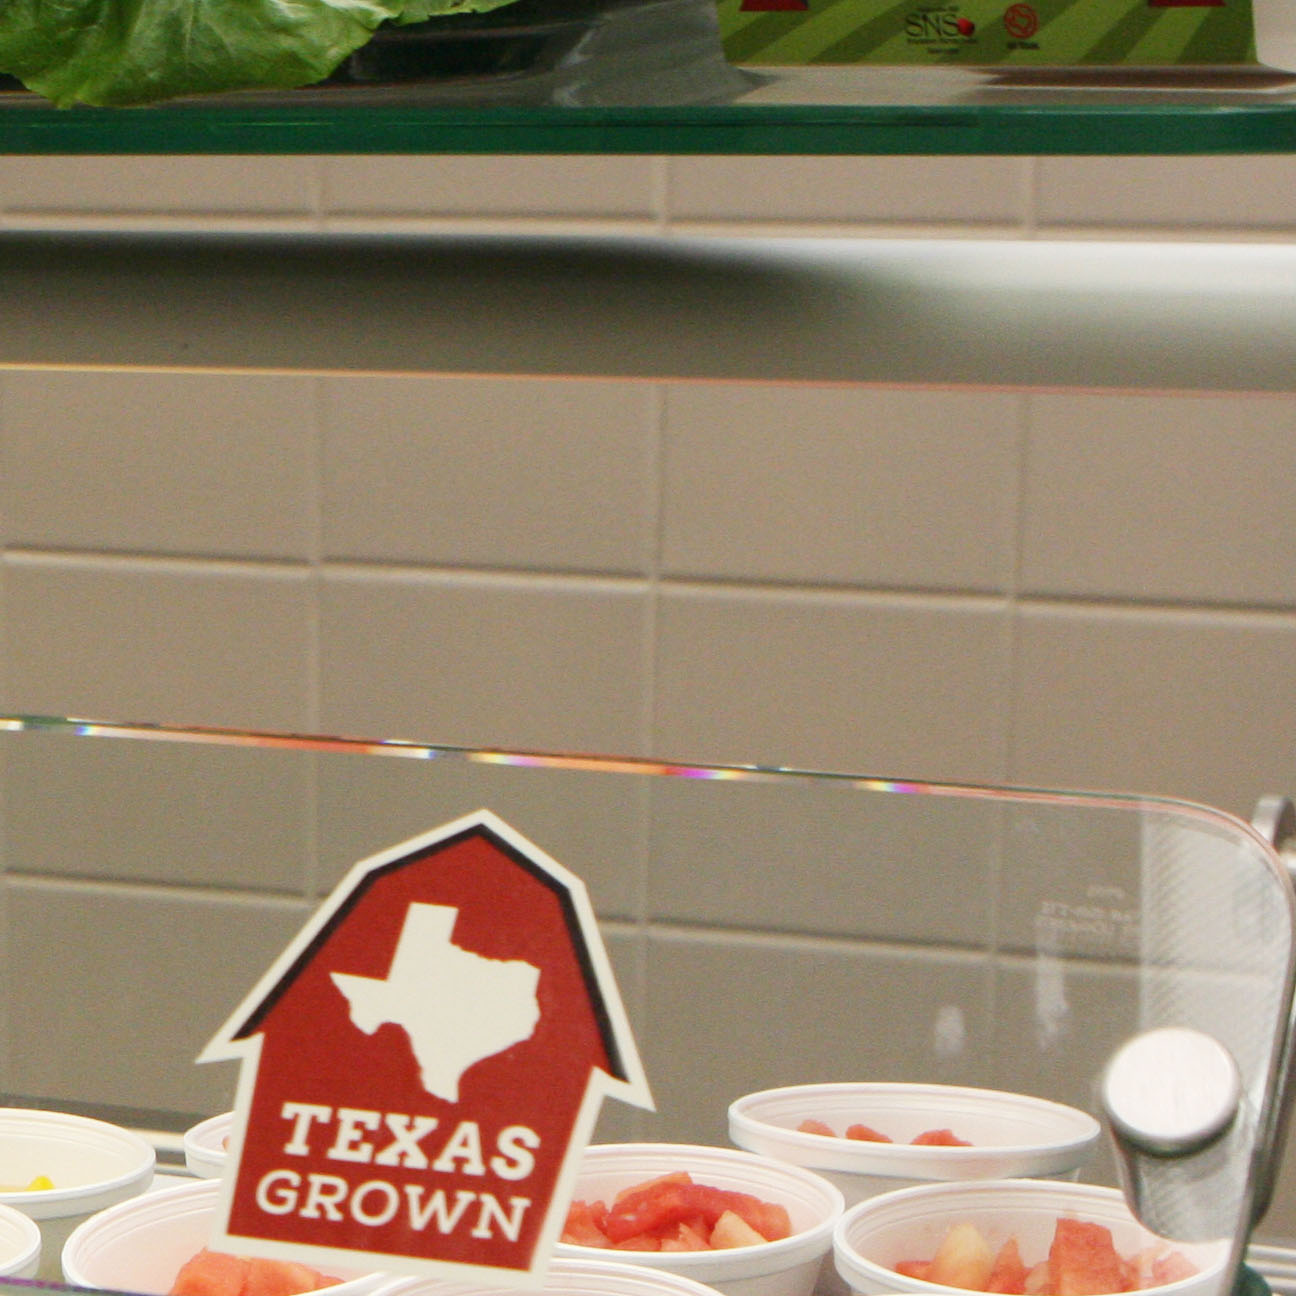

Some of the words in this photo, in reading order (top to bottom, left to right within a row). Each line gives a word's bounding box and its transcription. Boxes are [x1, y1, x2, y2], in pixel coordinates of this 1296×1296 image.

[905, 13, 959, 37] SNS
[281, 1101, 541, 1181] TEXAS
[255, 1169, 531, 1242] GROWN
